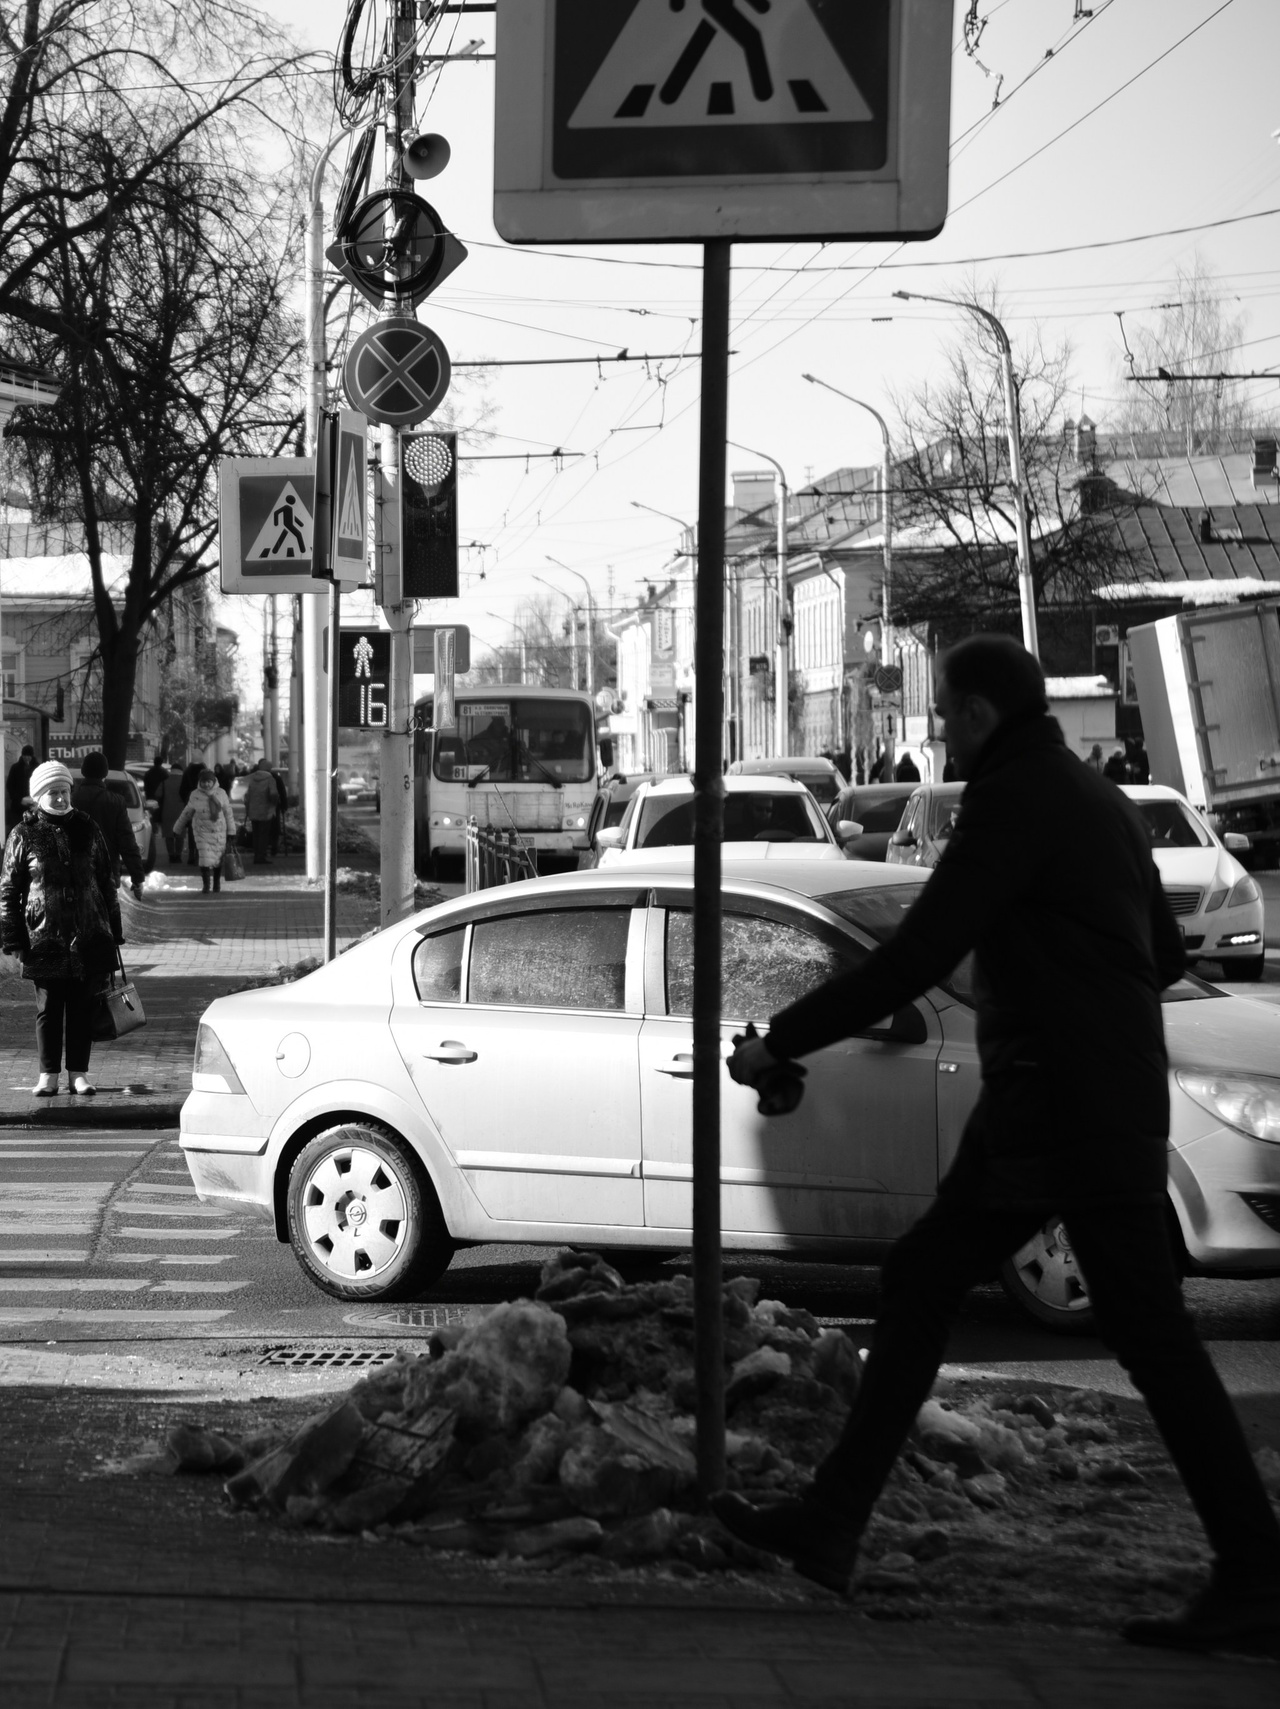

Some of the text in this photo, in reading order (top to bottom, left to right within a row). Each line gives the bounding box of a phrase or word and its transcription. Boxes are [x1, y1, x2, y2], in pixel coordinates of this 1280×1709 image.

[360, 683, 387, 726] 16
[48, 746, 75, 759] ЕТЫ
[454, 767, 465, 778] 81
